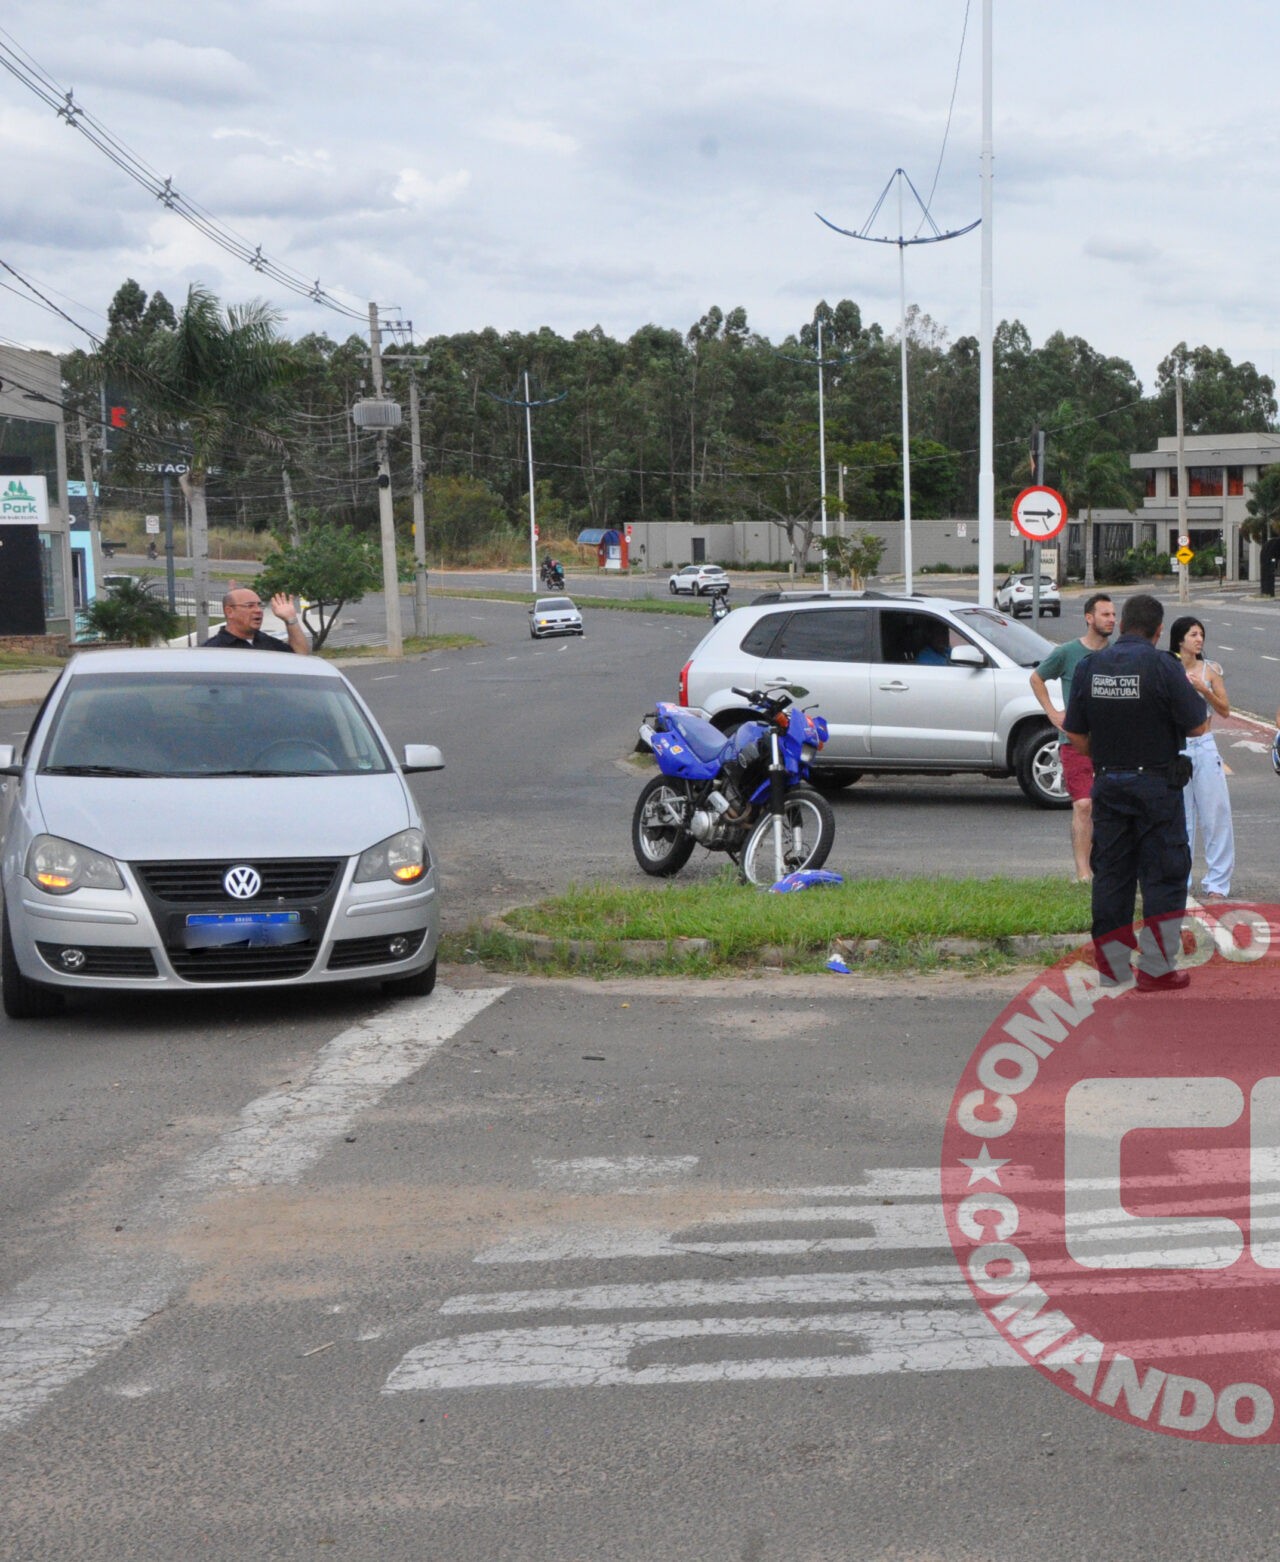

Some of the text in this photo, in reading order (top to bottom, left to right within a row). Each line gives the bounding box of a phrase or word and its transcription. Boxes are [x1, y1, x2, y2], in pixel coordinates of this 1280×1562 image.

[3, 502, 37, 513] Park
[1094, 677, 1137, 686] GUARDA CIVIL
[1093, 687, 1137, 696] INDAIATUBA
